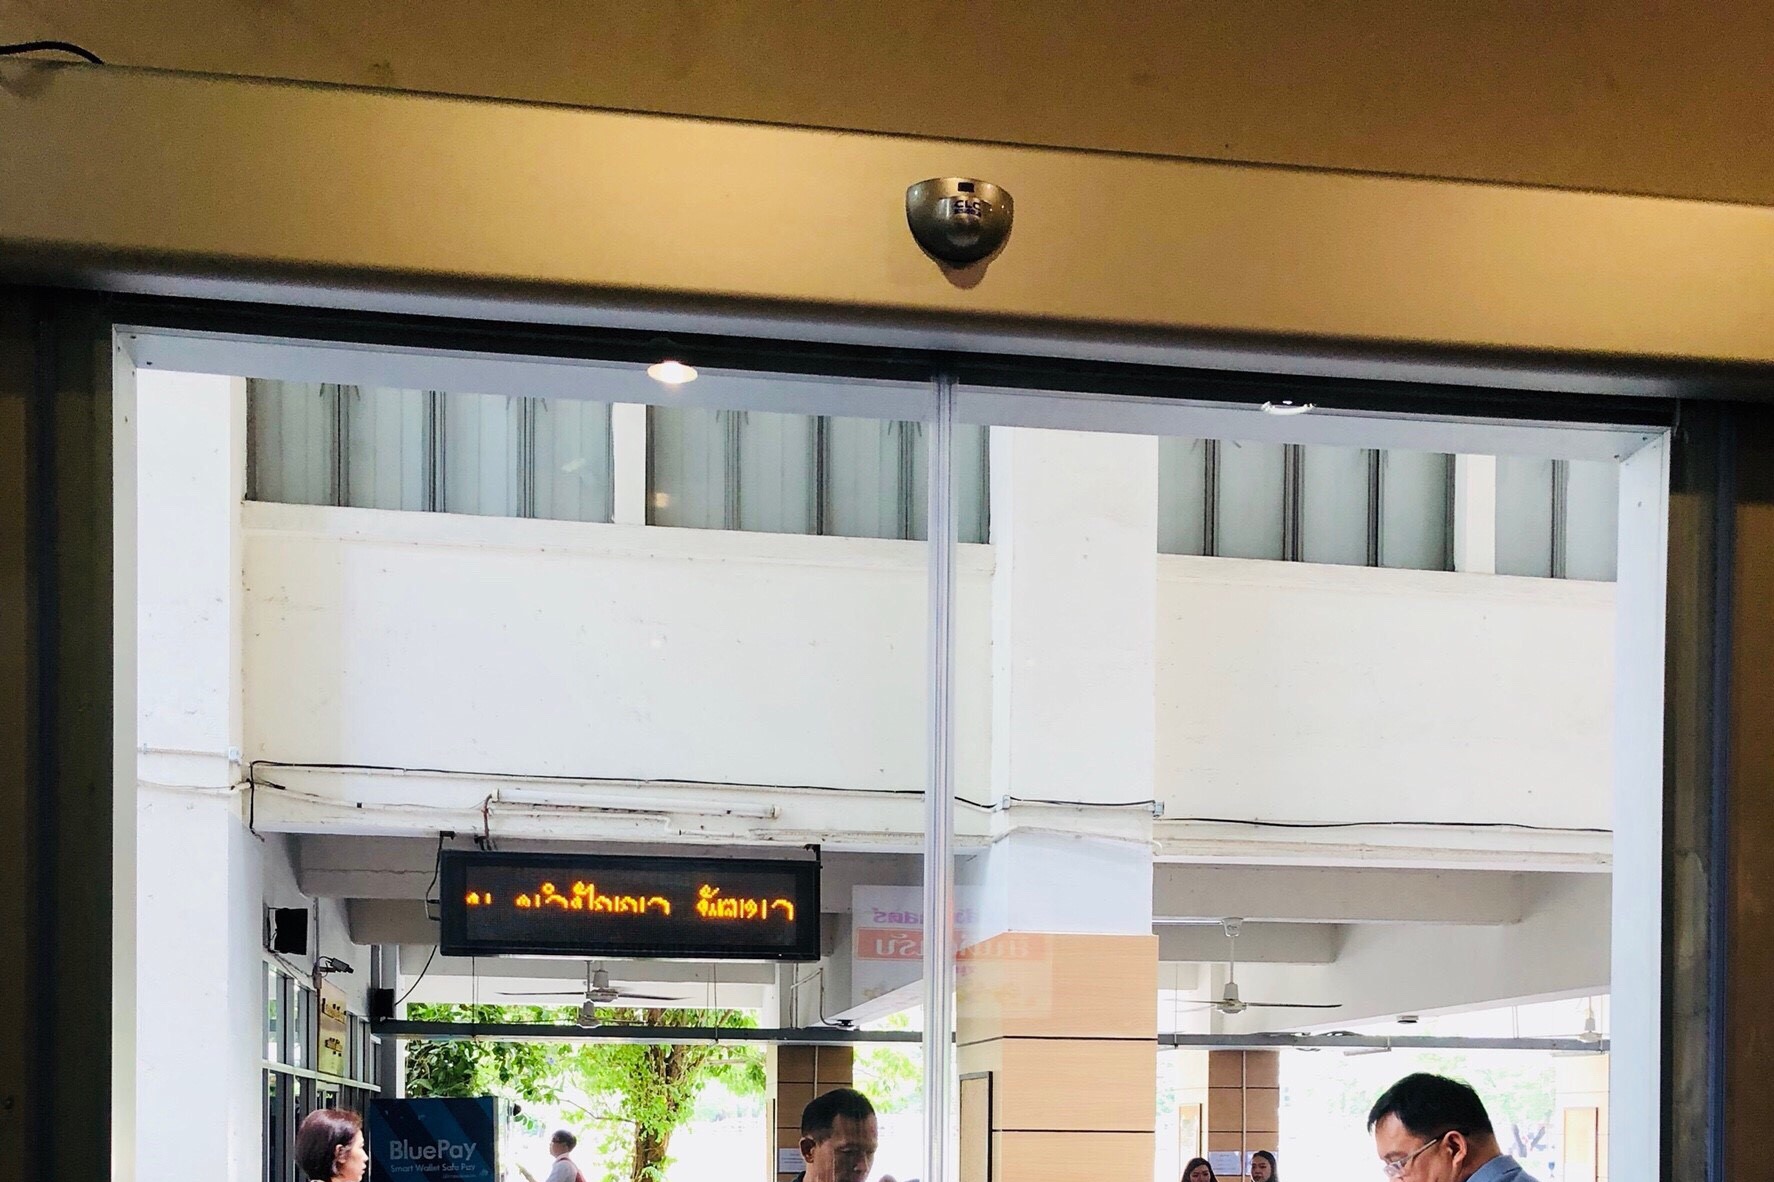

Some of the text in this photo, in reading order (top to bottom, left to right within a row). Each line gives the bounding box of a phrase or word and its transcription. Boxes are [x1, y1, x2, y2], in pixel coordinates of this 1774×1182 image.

[954, 200, 981, 211] CLC
[390, 1139, 476, 1160] BluePay
[415, 1164, 441, 1172] Wallet
[461, 1163, 475, 1172] Pay
